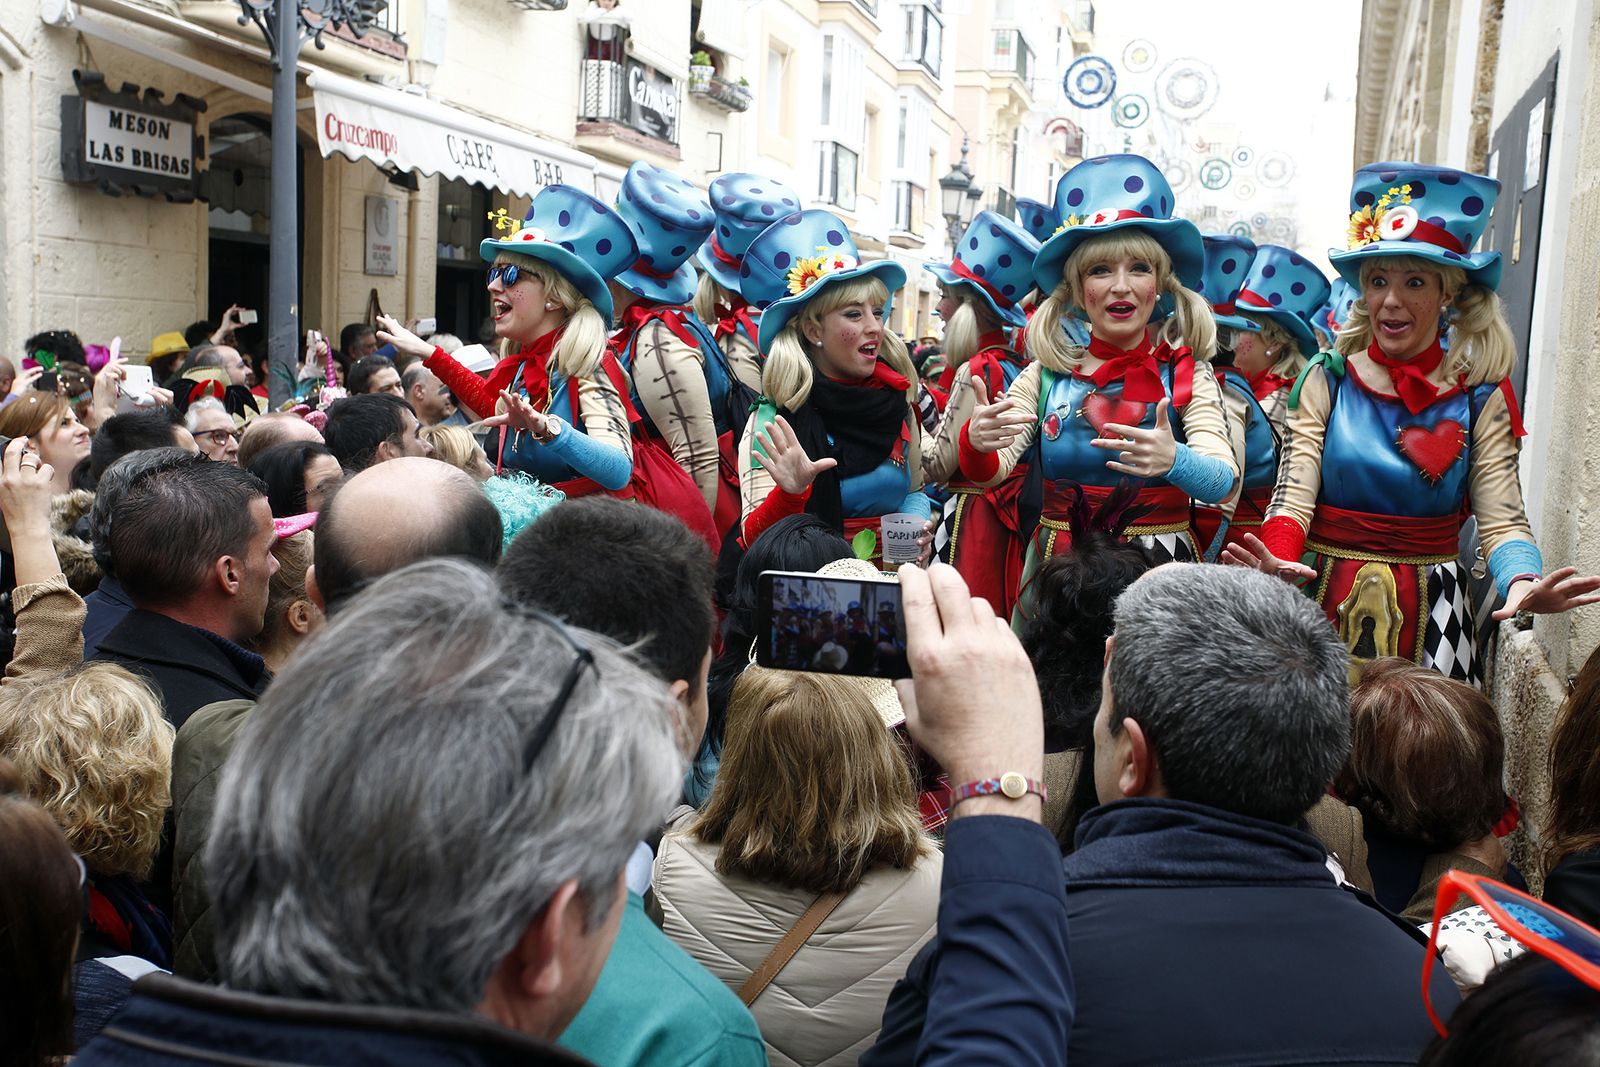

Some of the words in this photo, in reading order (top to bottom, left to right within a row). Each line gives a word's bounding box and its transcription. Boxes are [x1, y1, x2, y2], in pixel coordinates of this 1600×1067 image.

[109, 110, 171, 140] MESON
[325, 113, 398, 157] Cruzcampo
[89, 140, 125, 163] LAS
[131, 148, 190, 175] BRISAS
[533, 159, 564, 186] BAR
